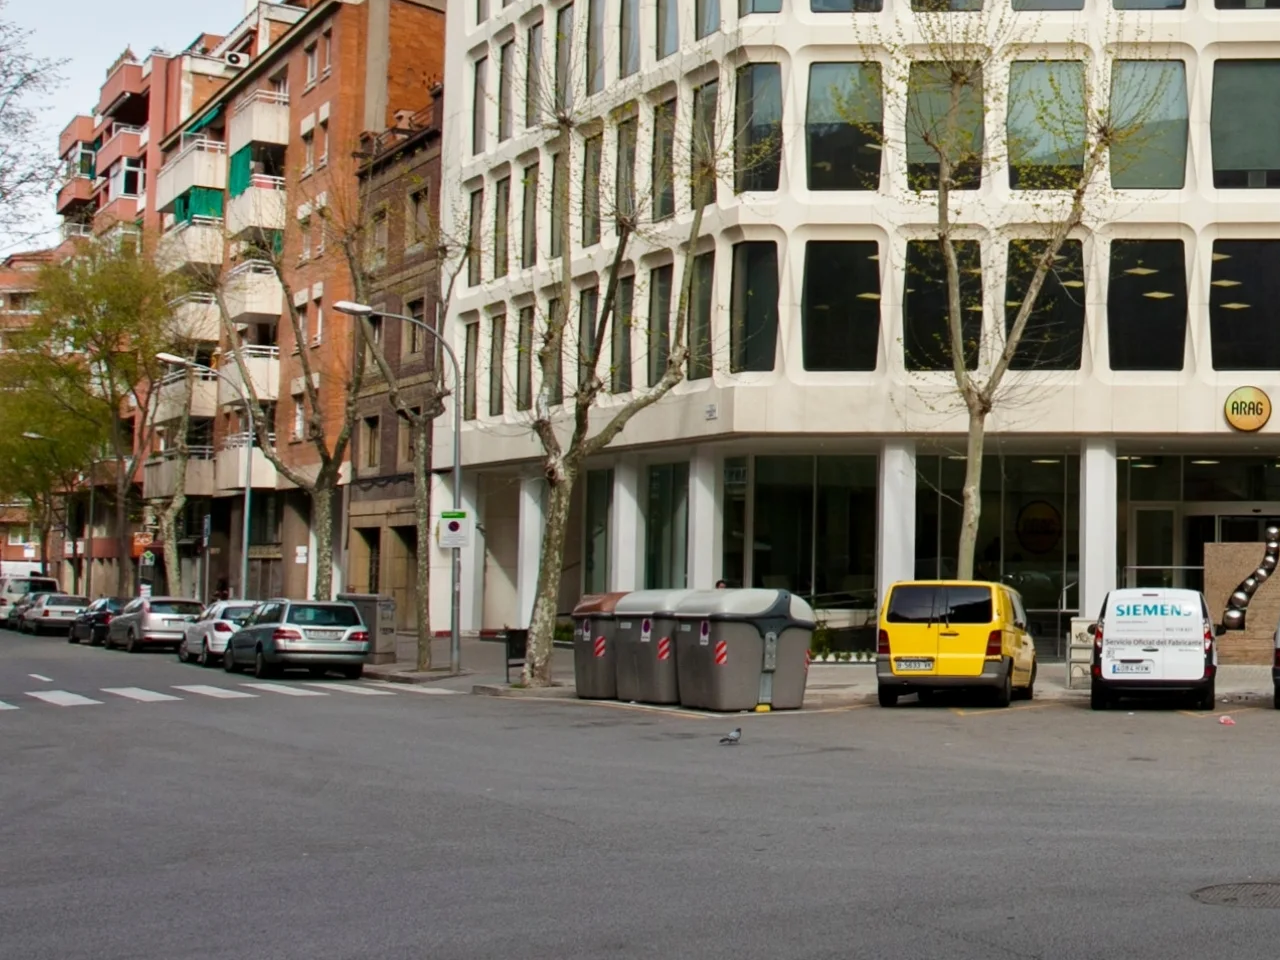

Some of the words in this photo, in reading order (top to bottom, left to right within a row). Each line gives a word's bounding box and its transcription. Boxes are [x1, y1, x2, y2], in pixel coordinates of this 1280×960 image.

[1231, 401, 1263, 416] ARAG
[1105, 638, 1132, 646] Servicio
[1133, 638, 1155, 646] Oficial
[1156, 638, 1167, 646] del
[1168, 638, 1202, 646] Fabricante
